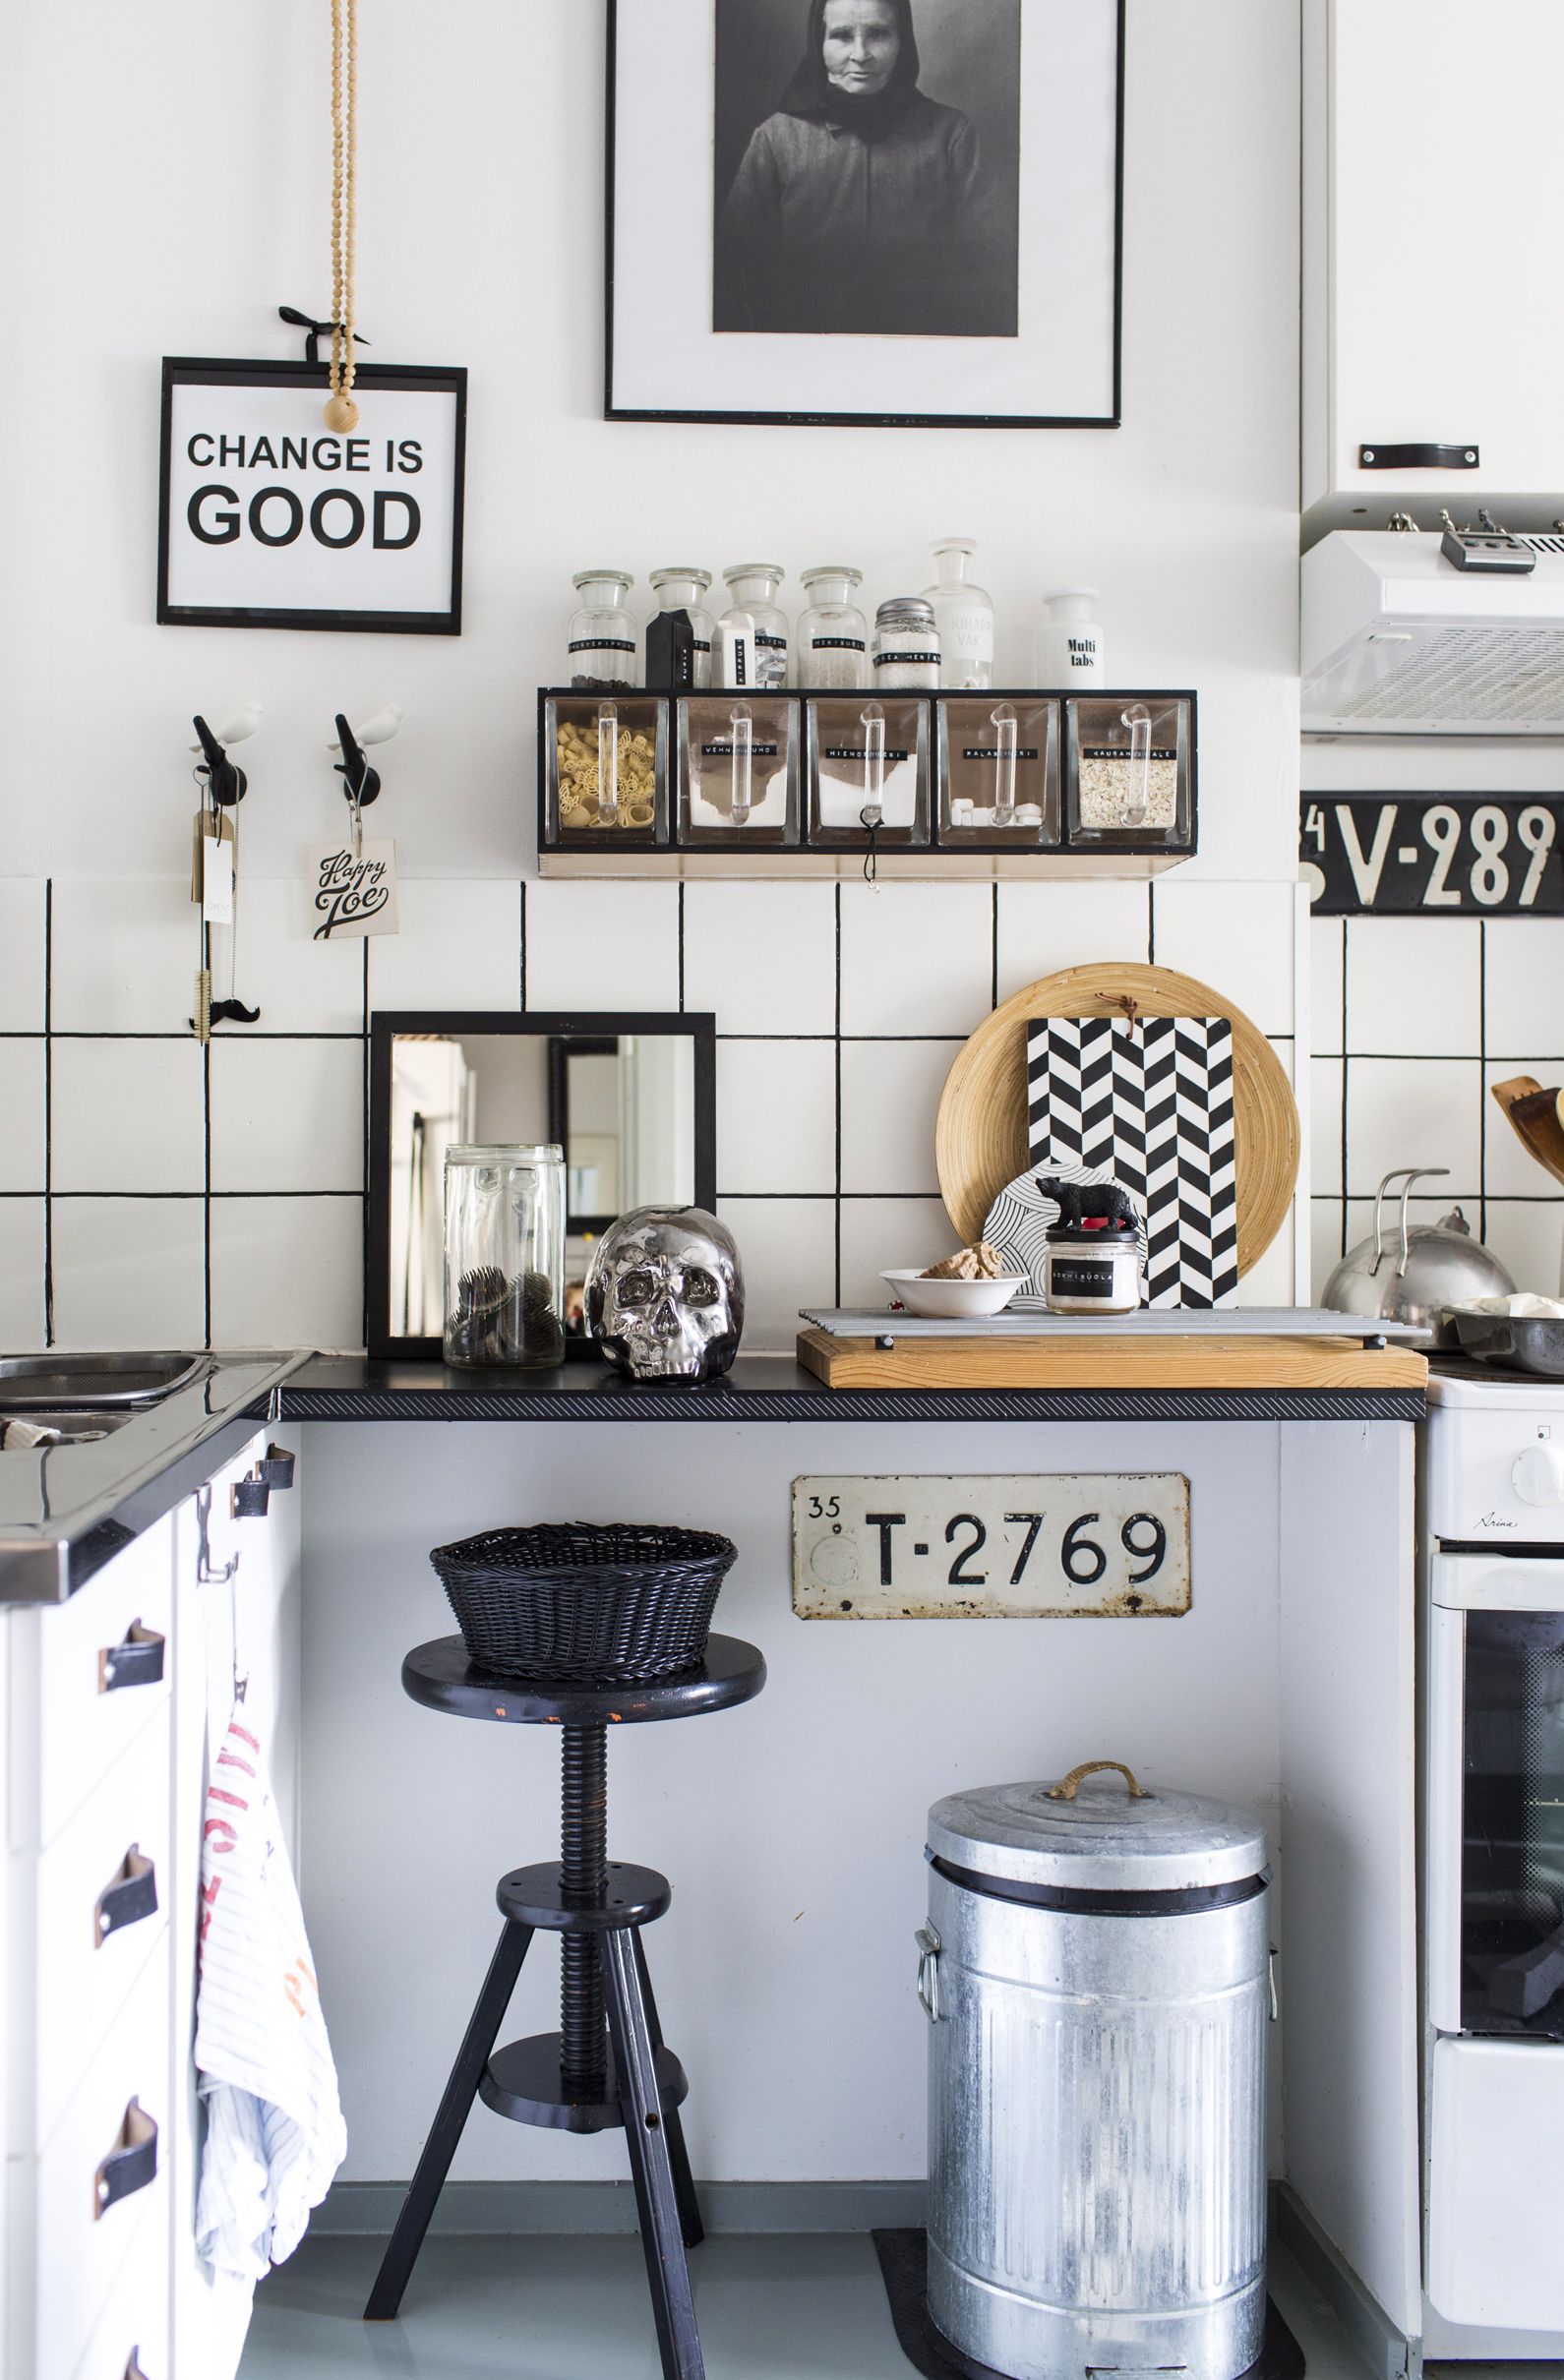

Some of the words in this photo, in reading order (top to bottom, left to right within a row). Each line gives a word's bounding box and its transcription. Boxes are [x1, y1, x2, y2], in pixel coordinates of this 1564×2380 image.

[186, 433, 371, 472] CHANGE
[386, 440, 424, 474] IS
[186, 484, 422, 551] GOOD
[1067, 638, 1096, 653] Multi
[1070, 653, 1095, 667] tabs
[319, 849, 388, 891] Happy
[808, 1495, 841, 1518] 35
[865, 1513, 1167, 1586] T-2769
